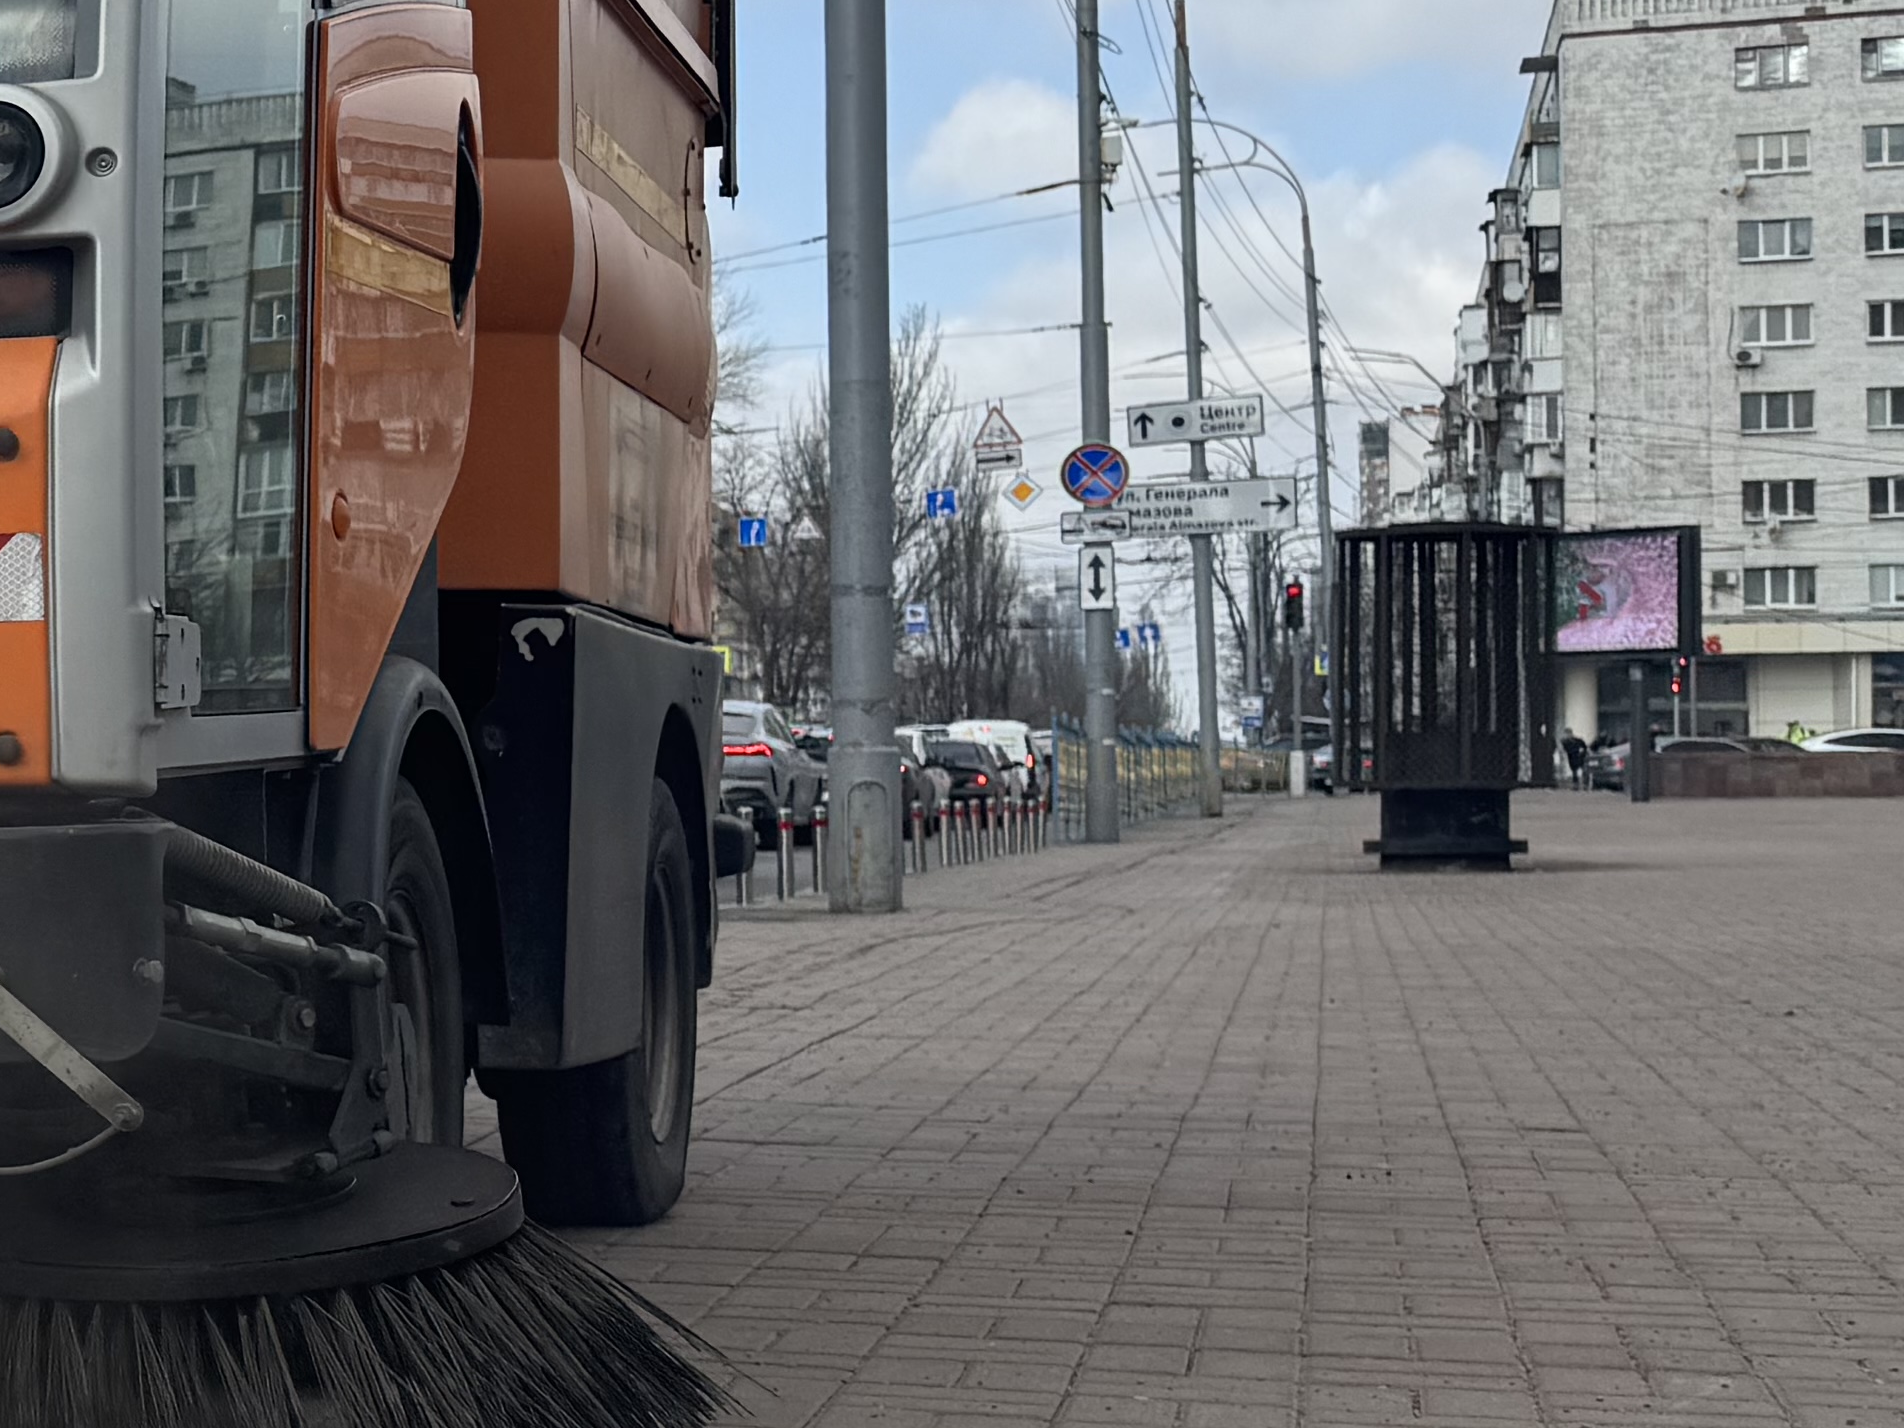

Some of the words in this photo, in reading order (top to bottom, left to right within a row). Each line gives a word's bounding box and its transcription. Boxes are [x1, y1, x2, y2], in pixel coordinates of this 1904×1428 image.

[1199, 404, 1257, 421] Центр
[1199, 422, 1246, 435] Centre
[1145, 486, 1230, 502] Генерала
[1130, 505, 1194, 521] мазова
